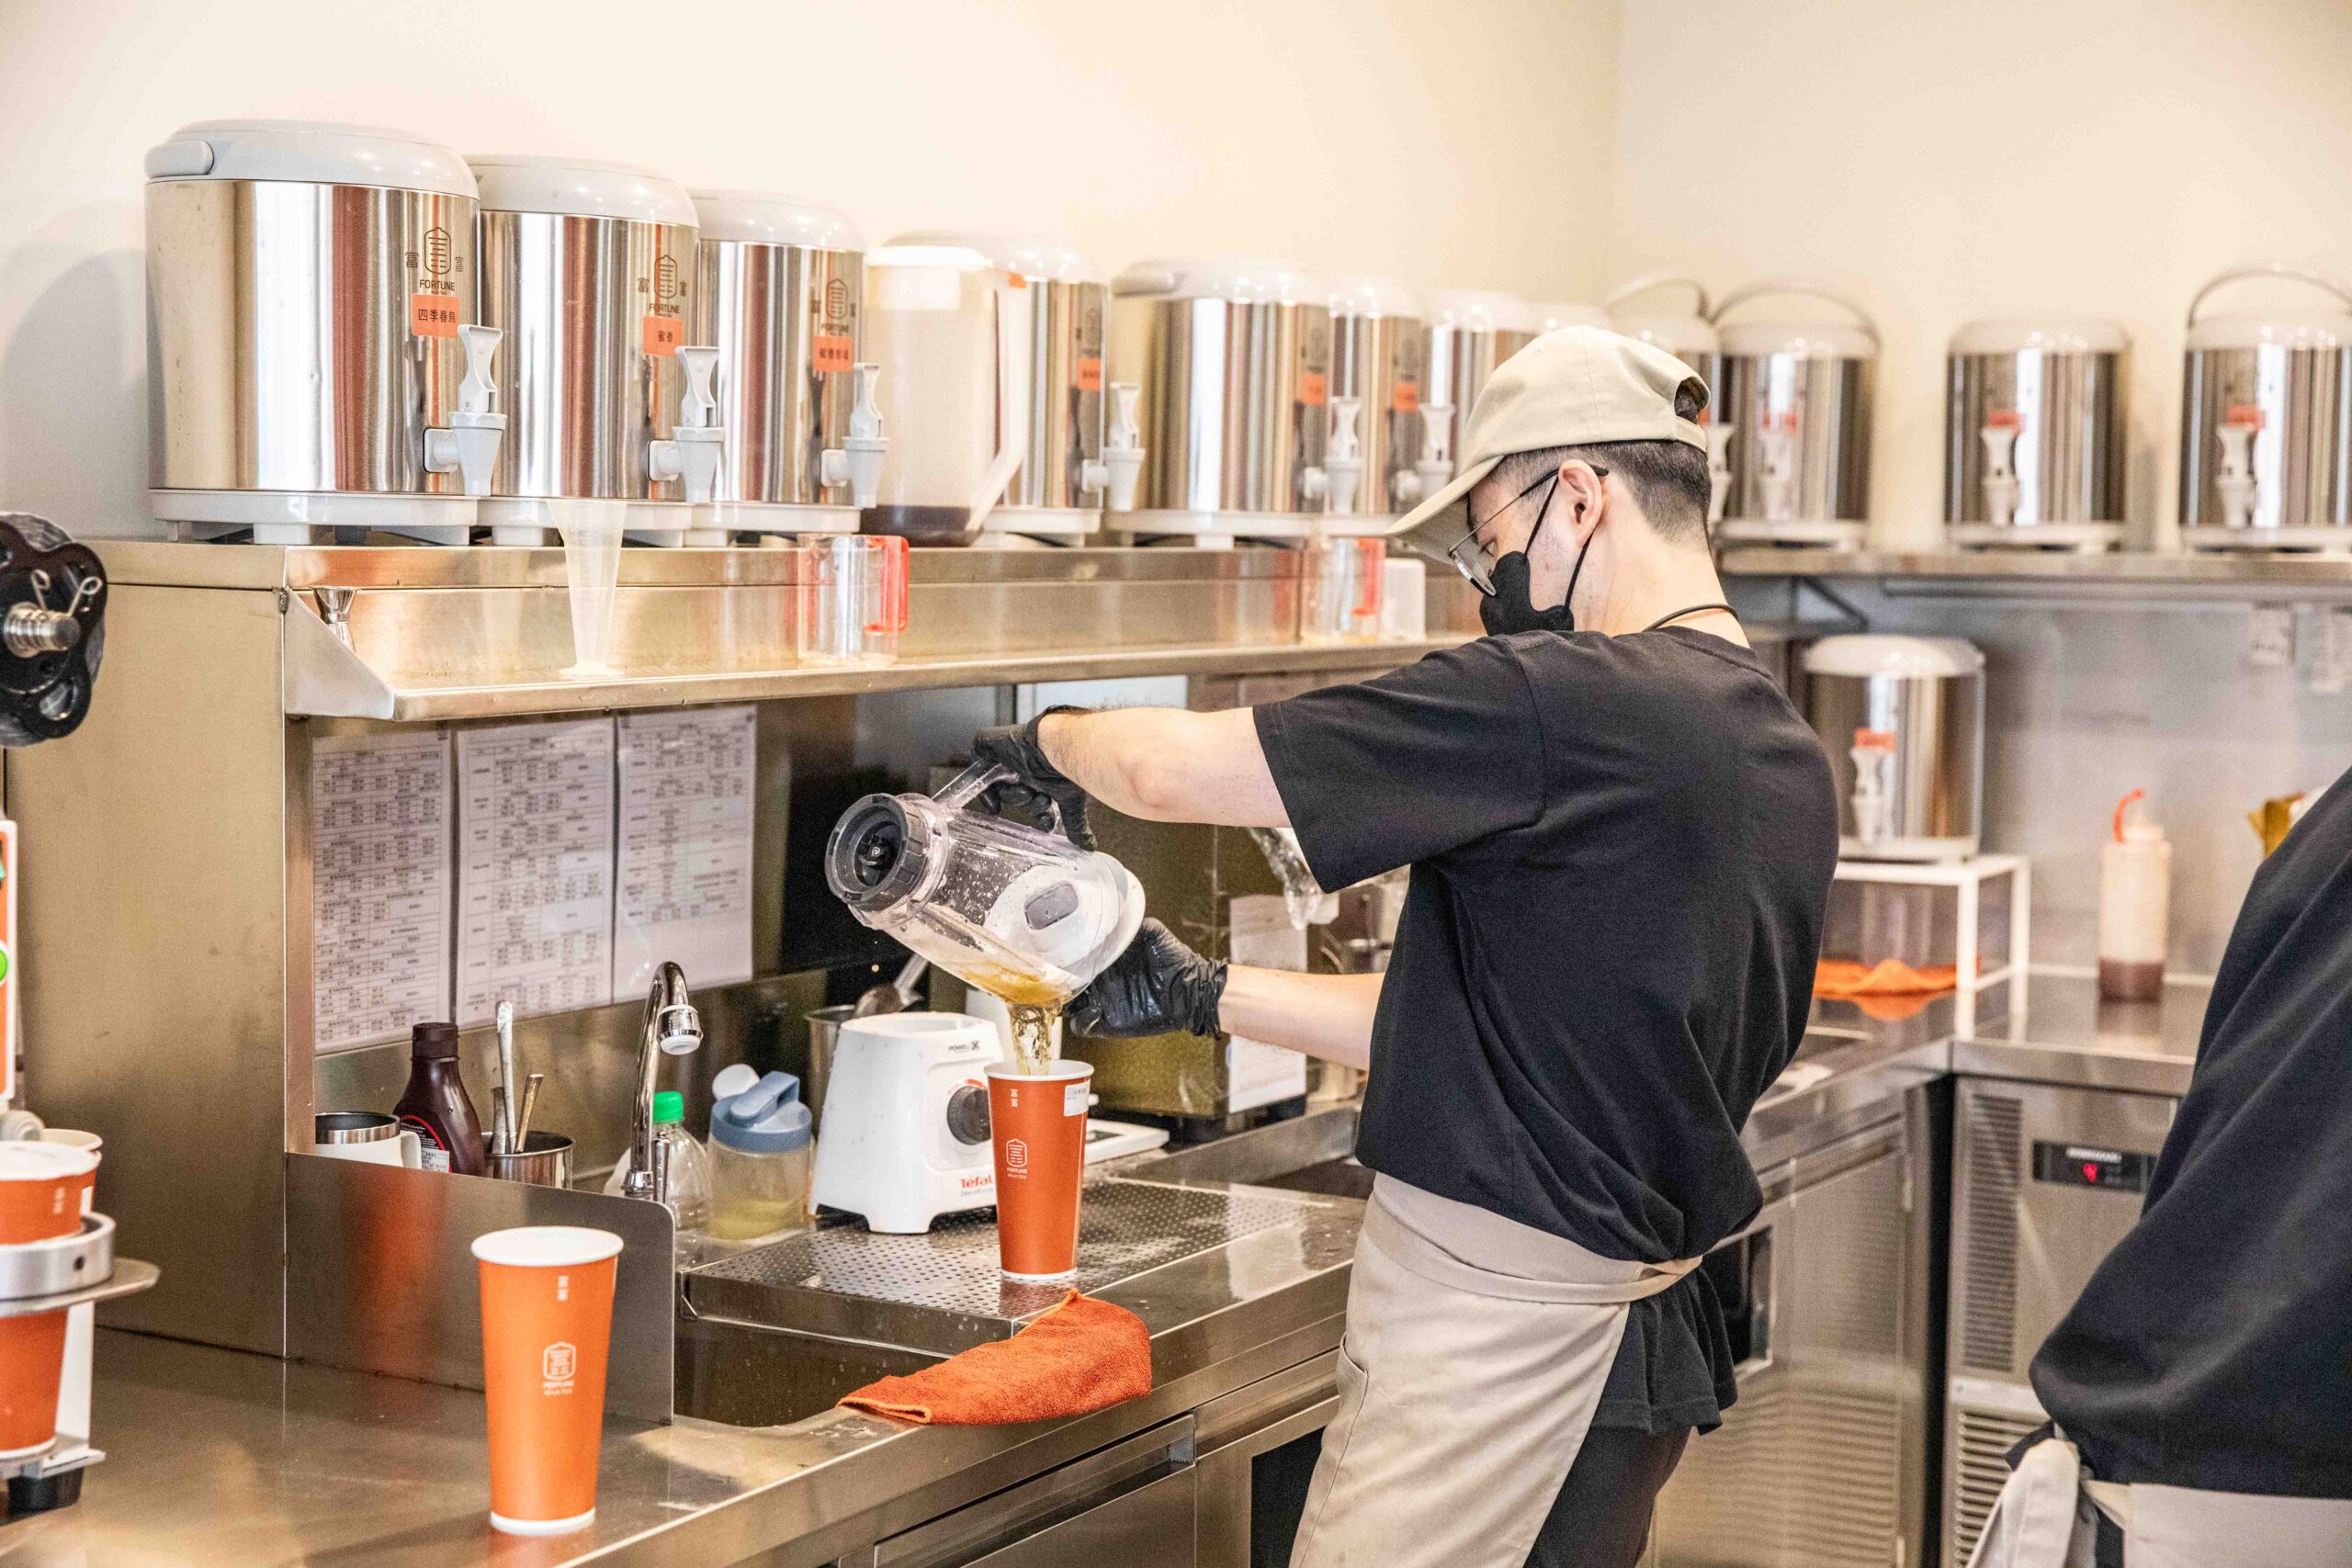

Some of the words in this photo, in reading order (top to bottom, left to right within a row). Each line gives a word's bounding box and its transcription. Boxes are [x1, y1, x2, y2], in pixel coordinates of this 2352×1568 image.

[419, 279, 456, 291] FORTUNE
[649, 302, 680, 314] FORTUNE
[960, 1174, 994, 1189] Tefal
